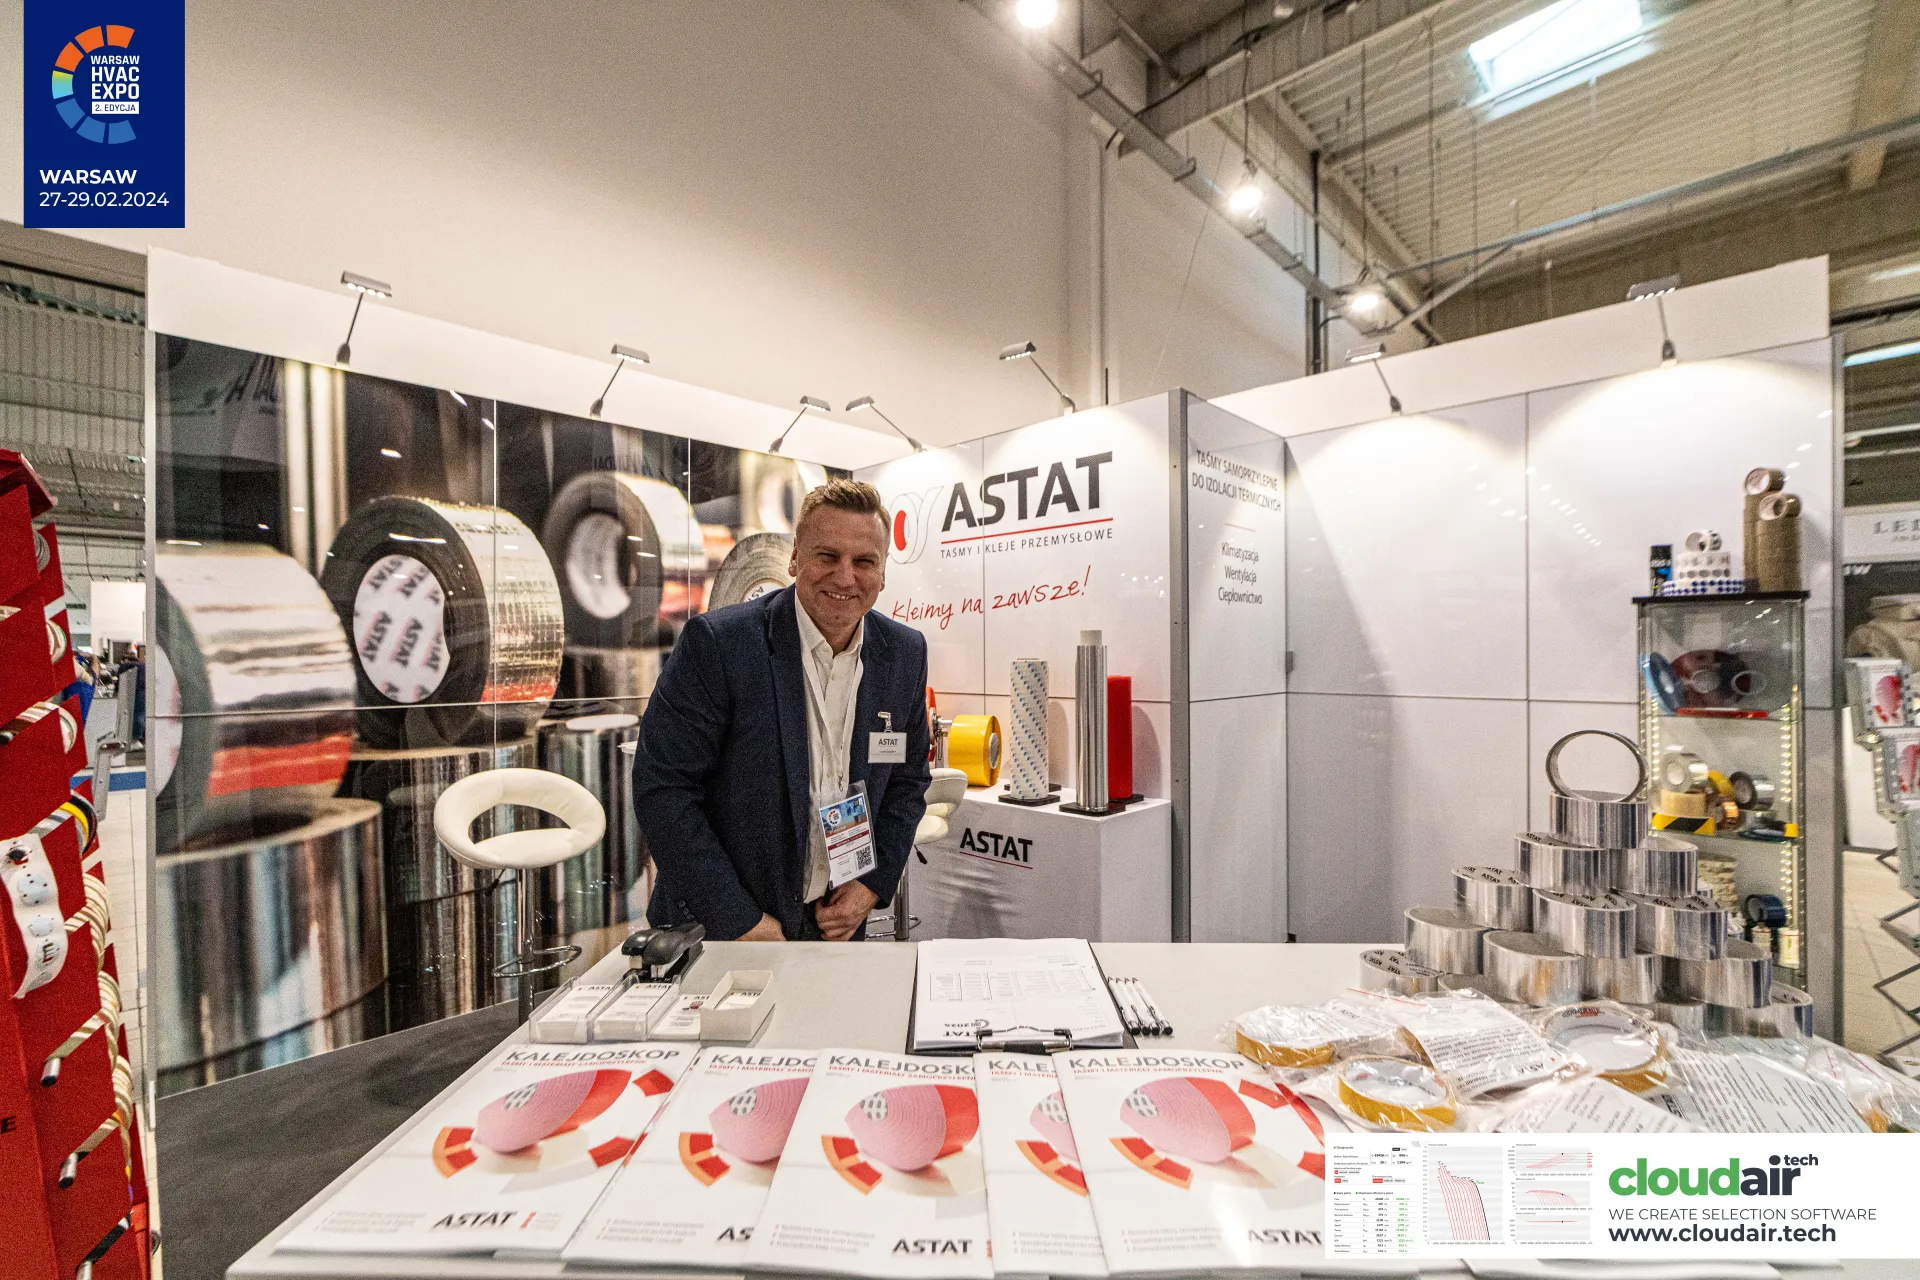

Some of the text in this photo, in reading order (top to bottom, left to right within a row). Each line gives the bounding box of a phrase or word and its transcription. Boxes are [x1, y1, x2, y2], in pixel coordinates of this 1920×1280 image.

[1196, 450, 1278, 491] TAŚMY SAMOPRZYLEPNE
[941, 451, 1112, 532] ASTAT
[1192, 472, 1281, 512] DO IZOLACJI TERMICZNYCH
[941, 546, 972, 559] TAŚMY
[985, 541, 1016, 554] KLEJE
[1021, 528, 1113, 550] PRZEMYSŁOWE
[1221, 542, 1259, 564] Klimatyzacja
[1224, 565, 1257, 586] Wentylacja
[1218, 586, 1263, 605] Ciepłownictwo
[961, 597, 984, 614] na
[877, 738, 899, 746] ASTAT
[960, 827, 1033, 863] ASTAT
[1525, 832, 1541, 842] ASTAT
[1481, 873, 1501, 883] ASTAT
[505, 1049, 680, 1061] KALEJDOSKOP
[711, 1054, 818, 1067] KALEJDO
[1069, 1056, 1245, 1069] KALEJDOSKOP
[829, 1055, 975, 1075] KALEJDOSK
[988, 1060, 1057, 1073] KALE
[908, 1073, 976, 1081] SAMOPRZYLEPN
[430, 1210, 520, 1230] ASTAT
[1248, 1229, 1324, 1246] ASTAT
[892, 1239, 973, 1255] ASTAT
